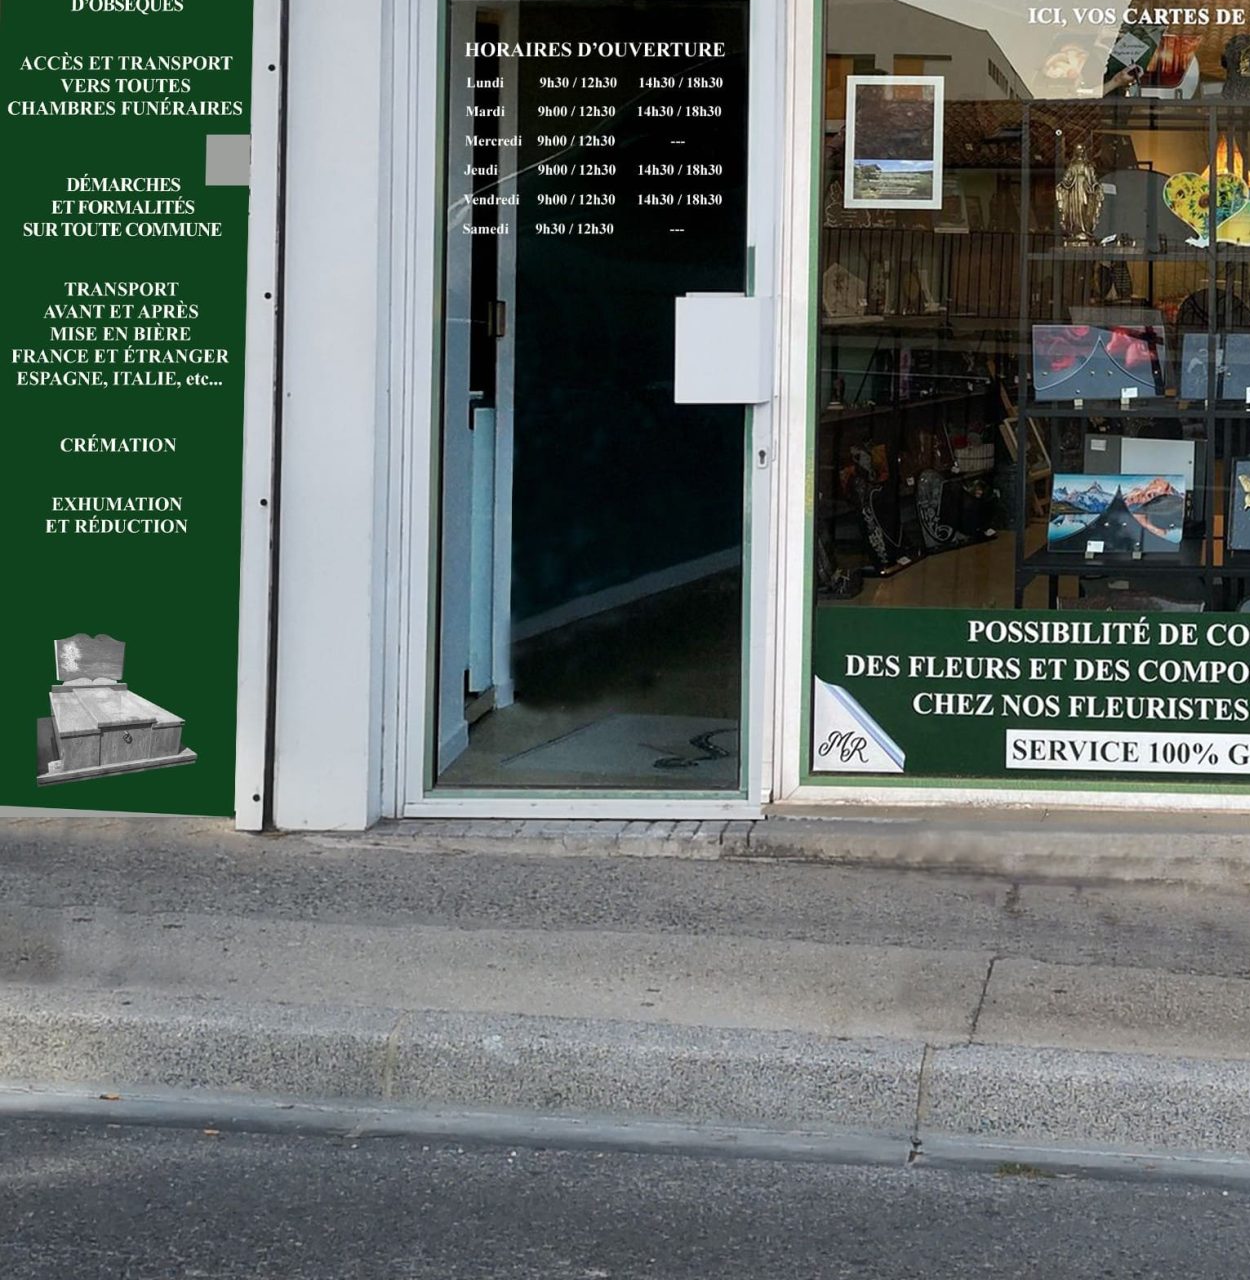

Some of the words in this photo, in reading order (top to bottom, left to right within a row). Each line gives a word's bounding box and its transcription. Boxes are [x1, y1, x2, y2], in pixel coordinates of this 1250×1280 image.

[1028, 7, 1067, 27] ICI,
[1072, 8, 1116, 24] VOS
[1122, 8, 1209, 25] CARTES
[1217, 9, 1245, 25] DE
[465, 42, 572, 57] HORAIRES
[578, 42, 725, 57] D'OUVERTURE
[20, 51, 84, 71] ACCÈS
[89, 55, 114, 71] ET
[117, 55, 234, 71] TRANSPORT
[60, 78, 111, 93] VERS
[115, 78, 191, 93] TOUTES
[467, 77, 504, 88] Lundi
[539, 76, 570, 88] 9h30
[582, 76, 618, 88] 12h30
[640, 76, 675, 88] 14h30
[688, 76, 724, 88] 18h30
[7, 100, 116, 116] CHAMBRES
[121, 96, 243, 116] FUNÉRAIRES
[466, 106, 505, 117] Mardi
[465, 135, 522, 147] Mercredi
[464, 164, 497, 176] Jeudi
[67, 173, 181, 192] DÉMARCHES
[52, 200, 76, 215] ET
[78, 195, 195, 215] FORMALITÉS
[464, 194, 519, 205] Vendredi
[23, 222, 59, 237] SUR
[60, 222, 122, 237] TOUTE
[125, 222, 222, 237] COMMUNE
[462, 223, 509, 235] Samedi
[535, 223, 566, 235] 9h30
[577, 223, 614, 235] 12h30
[64, 281, 179, 297] TRANSPORT
[43, 304, 106, 319] AVANT
[110, 304, 135, 319] ET
[137, 300, 199, 319] APRÈS
[50, 326, 97, 341] MISE
[103, 326, 128, 341] EN
[134, 322, 191, 341] BIÈRE
[12, 348, 89, 364] FRANCE
[94, 348, 119, 364] ET
[124, 344, 229, 364] ÉTRANGER
[17, 370, 108, 389] ESPAGNE,
[113, 371, 182, 389] ITALIE,
[185, 373, 223, 386] etc...
[60, 433, 176, 453] CRÉMATION
[52, 496, 182, 512] EXHUMATION
[46, 519, 70, 534] ET
[75, 514, 188, 534] RÉDUCTION
[968, 616, 1151, 645] POSSIBILITÉ
[1158, 623, 1198, 646] DE
[845, 654, 900, 678] DES
[909, 656, 1021, 680] FLEURS
[1029, 658, 1067, 680] ET
[1074, 659, 1130, 682] DES
[913, 692, 994, 716] CHEZ
[1001, 694, 1060, 718] NOS
[1069, 695, 1249, 721] FLEURISTES
[1012, 739, 1139, 763] SERVICE
[1151, 742, 1219, 765] 100%
